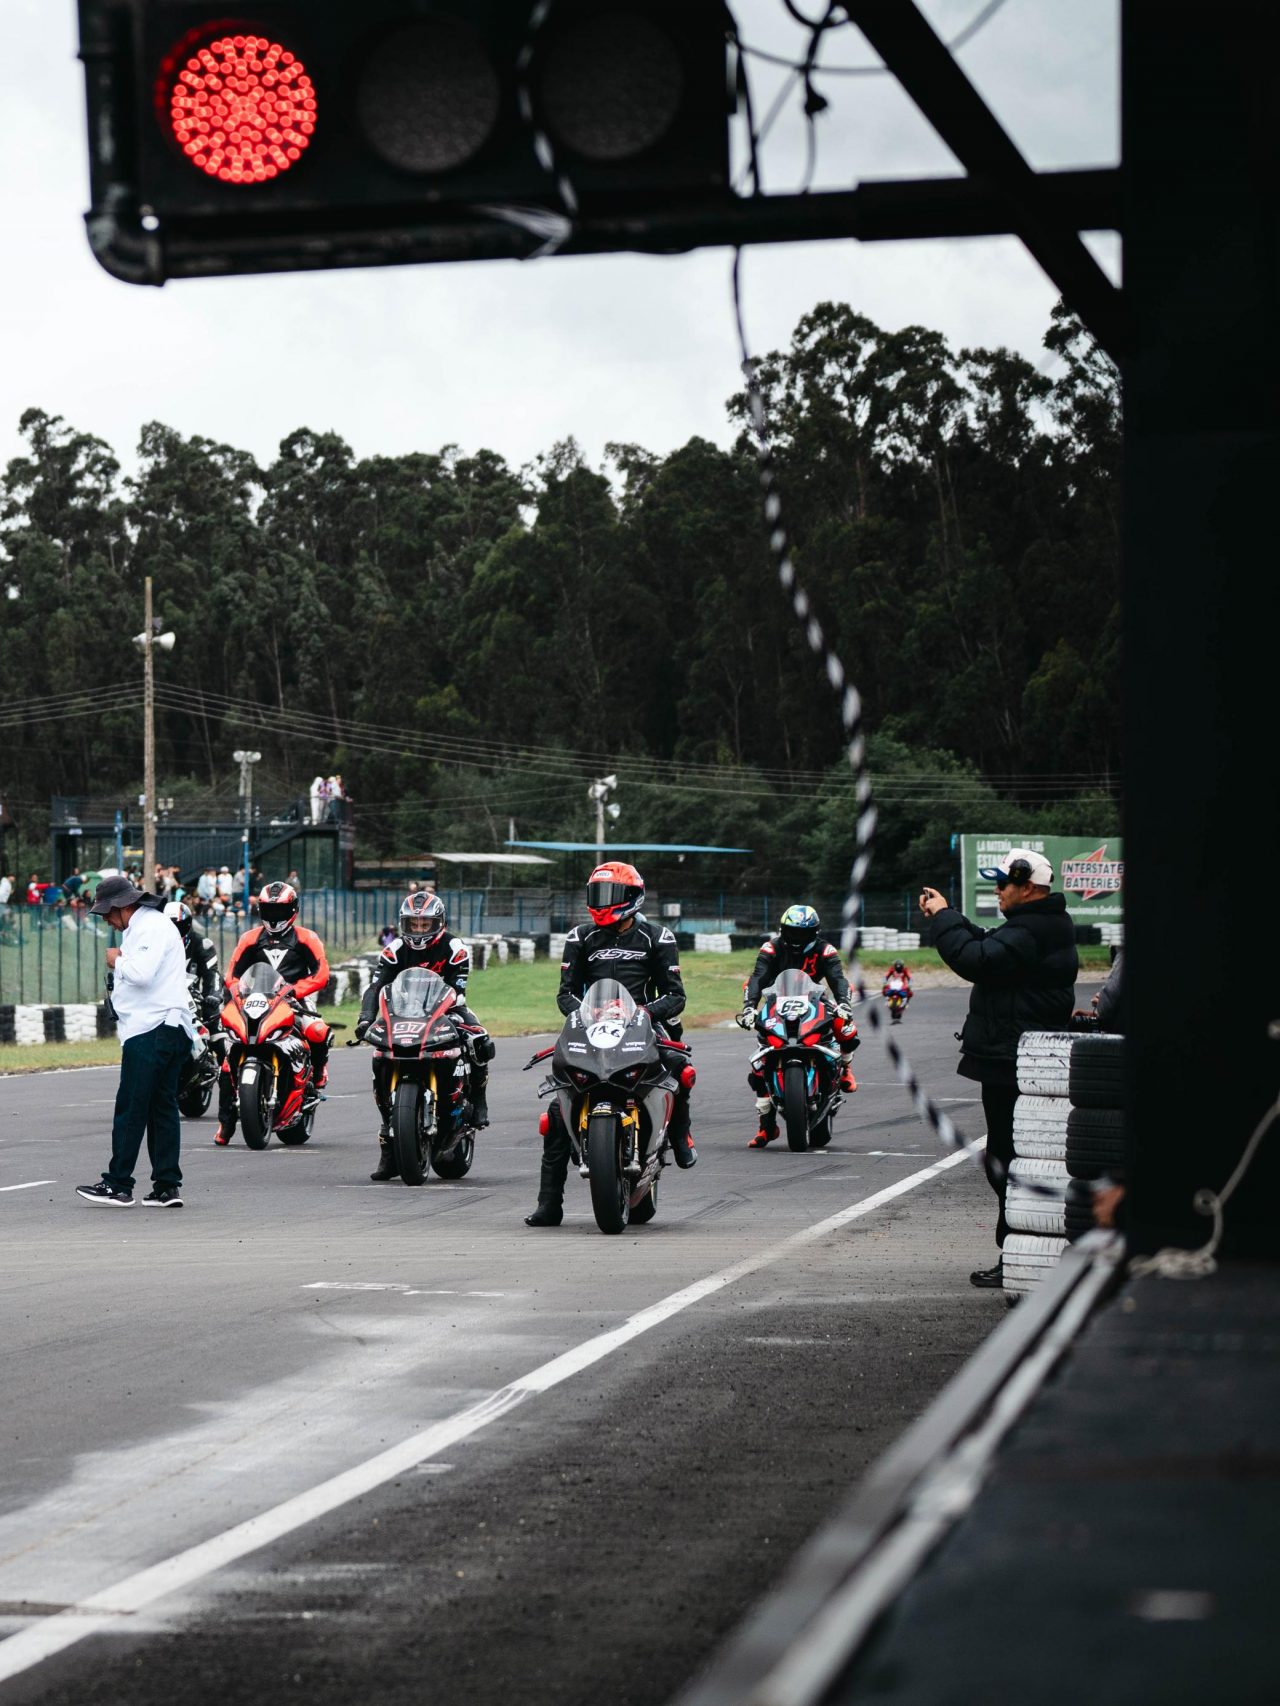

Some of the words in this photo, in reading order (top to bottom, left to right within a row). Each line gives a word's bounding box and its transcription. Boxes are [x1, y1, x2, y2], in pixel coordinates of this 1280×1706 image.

[1063, 863, 1124, 874] INTERSTATE
[1065, 878, 1121, 888] BATTERIES
[588, 948, 647, 961] RST
[245, 1000, 267, 1009] 909
[781, 1000, 805, 1013] 62
[393, 1021, 427, 1034] 97
